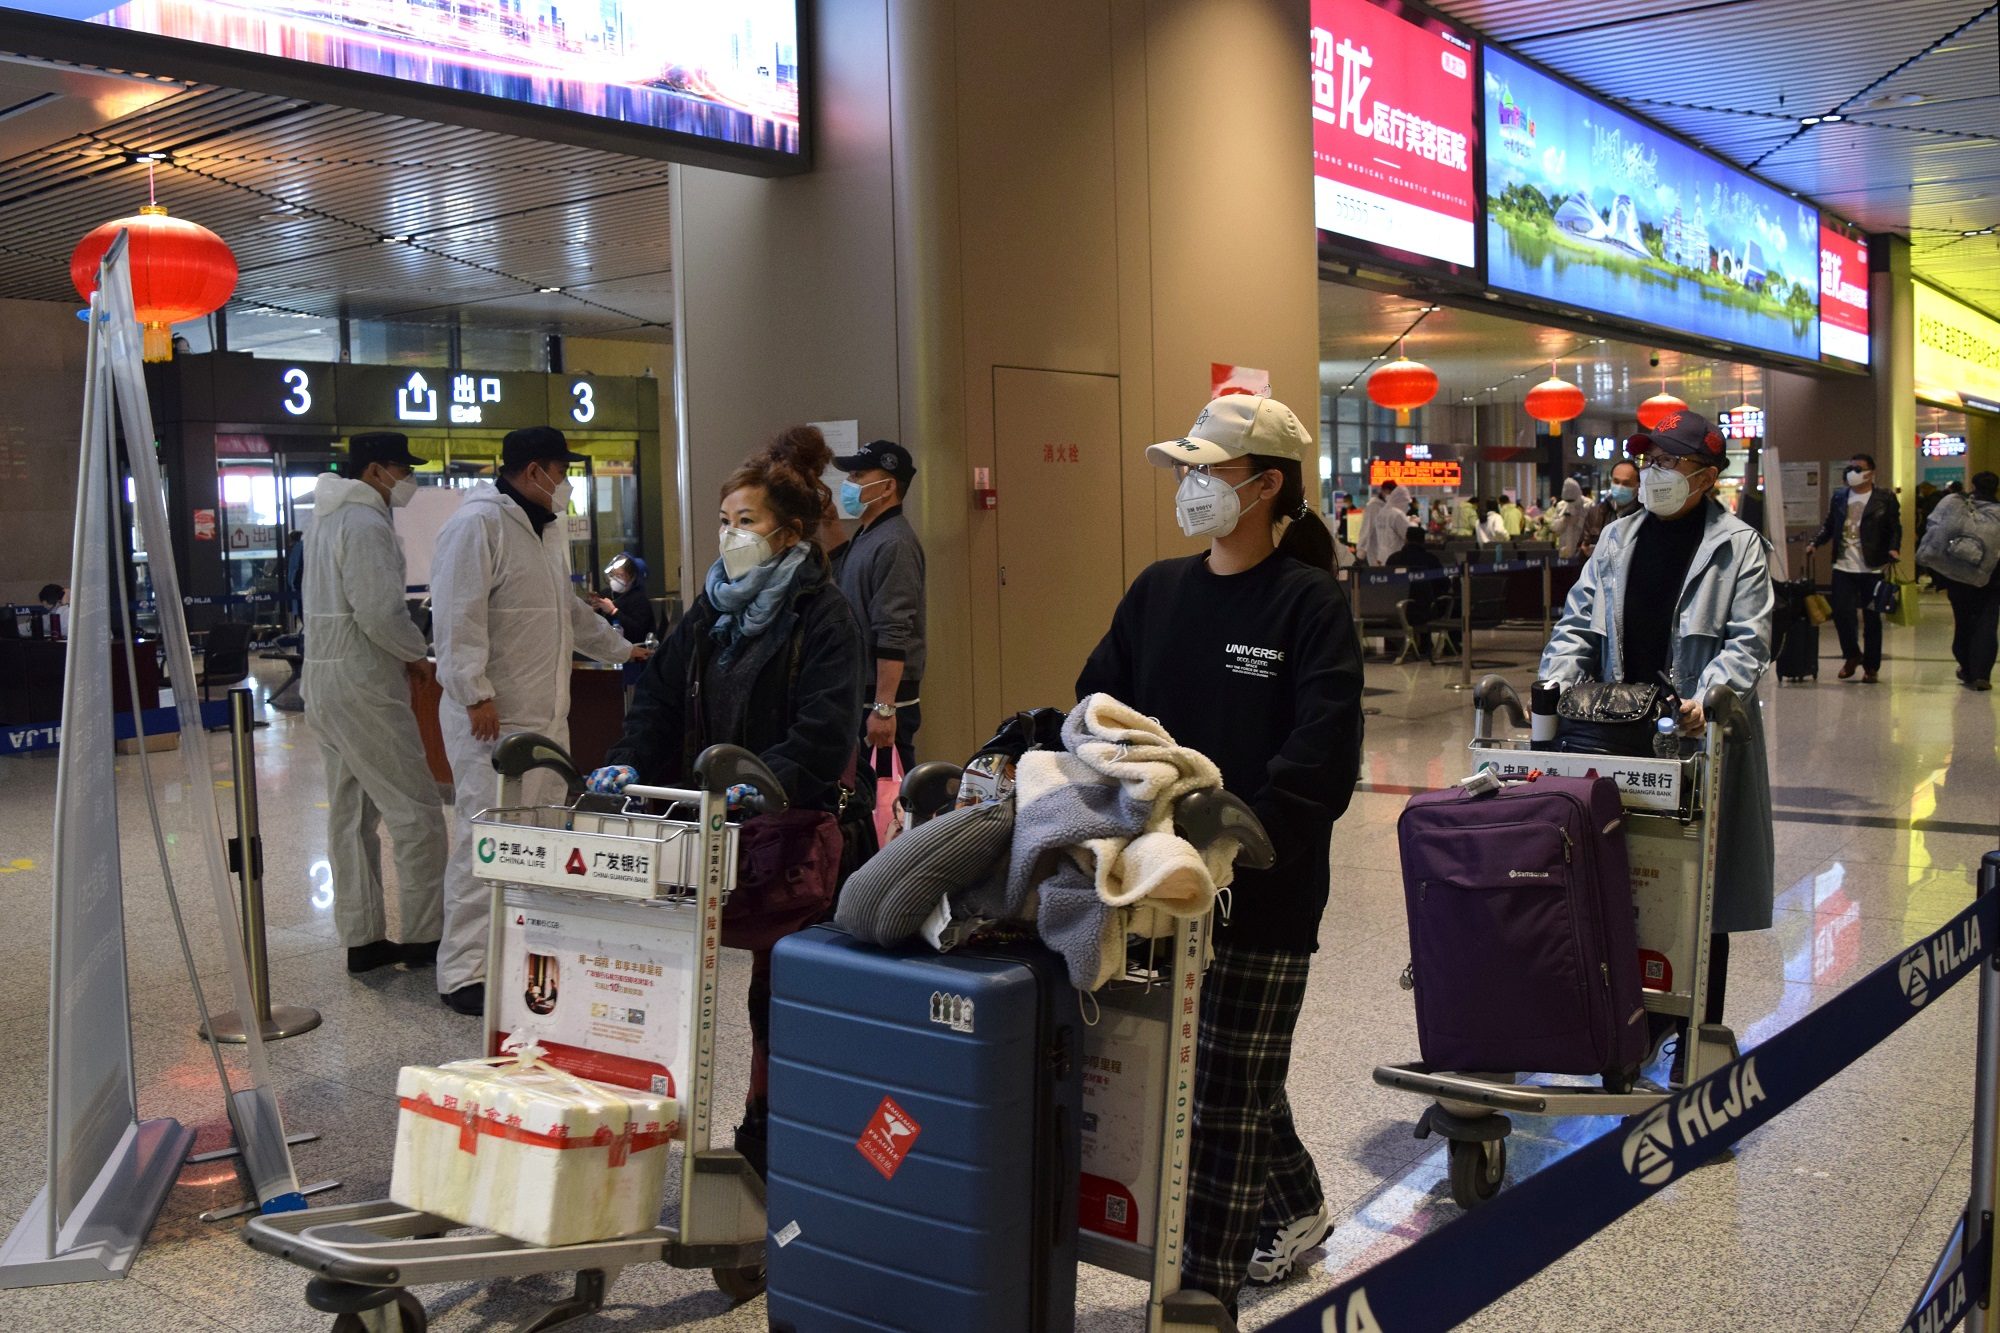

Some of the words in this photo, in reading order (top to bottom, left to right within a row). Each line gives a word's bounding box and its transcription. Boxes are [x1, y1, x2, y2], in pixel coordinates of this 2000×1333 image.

[1348, 162, 1385, 180] MEDICAL
[1388, 176, 1428, 194] COSMETIC
[284, 368, 311, 415] 3
[454, 374, 500, 404] 出口
[572, 382, 595, 422] 3
[1044, 444, 1080, 463] 消火栓
[1226, 644, 1284, 662] UNIVERSE
[1613, 770, 1672, 788] 广发银行
[500, 842, 546, 860] 中国人寿
[593, 851, 649, 875] 广发银行
[500, 856, 526, 866] CHINA
[528, 858, 546, 868] LIFE
[1933, 912, 1983, 980] HLJA
[1676, 1056, 1767, 1148] HLJA
[868, 1128, 900, 1160] FRAGILE
[1166, 1080, 1188, 1266] 4008-777-777
[1918, 1272, 1967, 1333] HLJA
